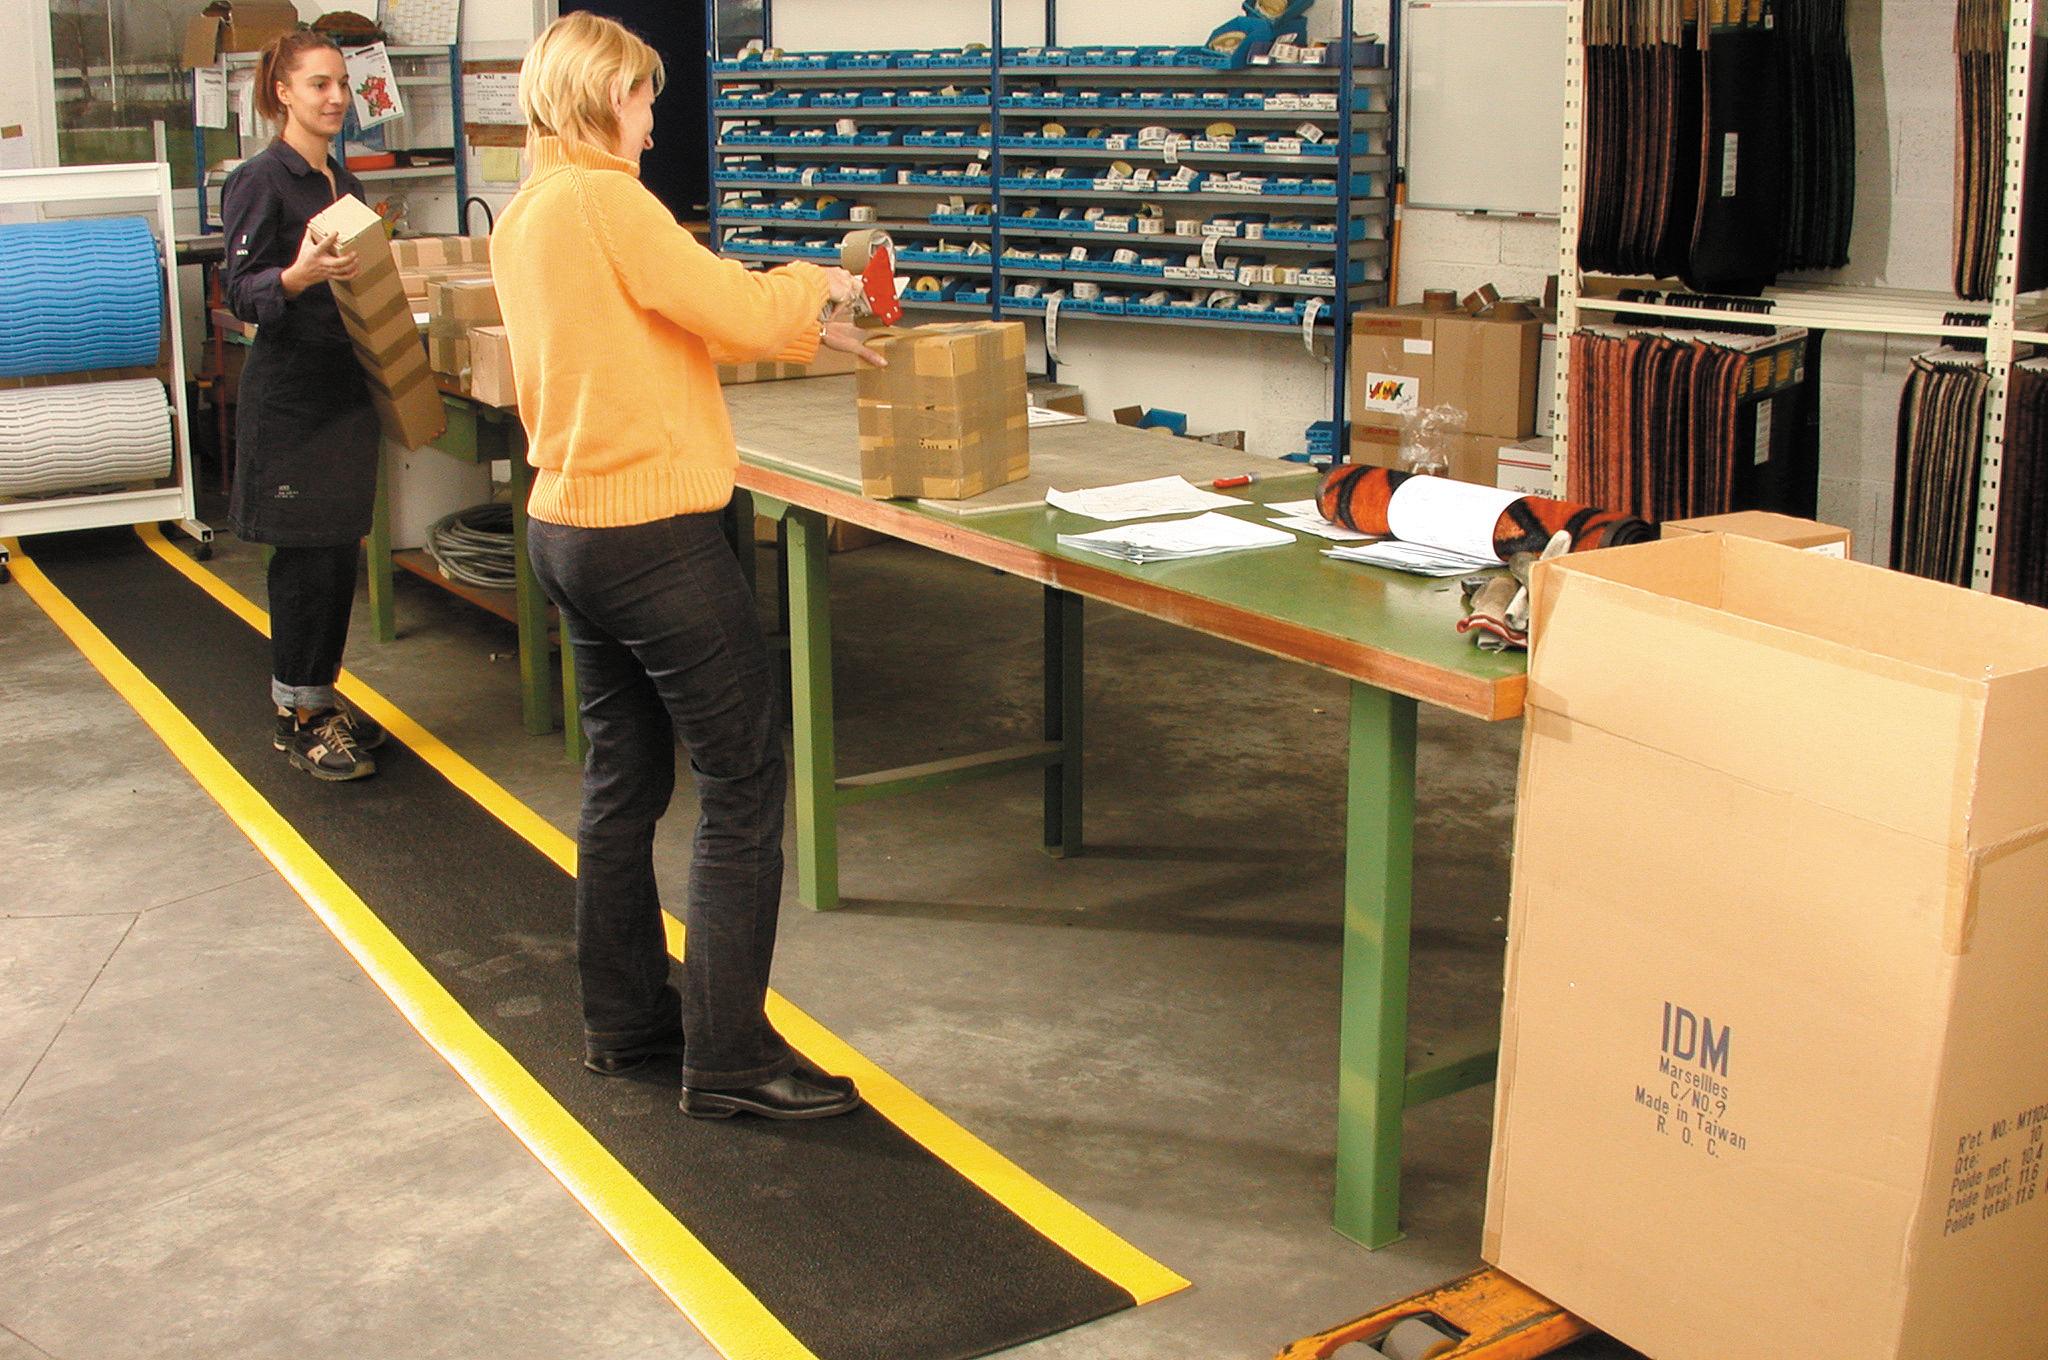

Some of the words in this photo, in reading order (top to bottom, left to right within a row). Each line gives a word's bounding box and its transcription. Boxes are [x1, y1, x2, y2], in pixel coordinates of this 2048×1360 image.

[1661, 1001, 1730, 1077] IDM
[1635, 1085, 1670, 1115] Made
[1676, 1103, 1688, 1124] in
[1697, 1113, 1746, 1151] Taiwan
[1656, 1115, 1669, 1135] R.
[1682, 1127, 1694, 1147] O.
[1707, 1138, 1719, 1158] C.
